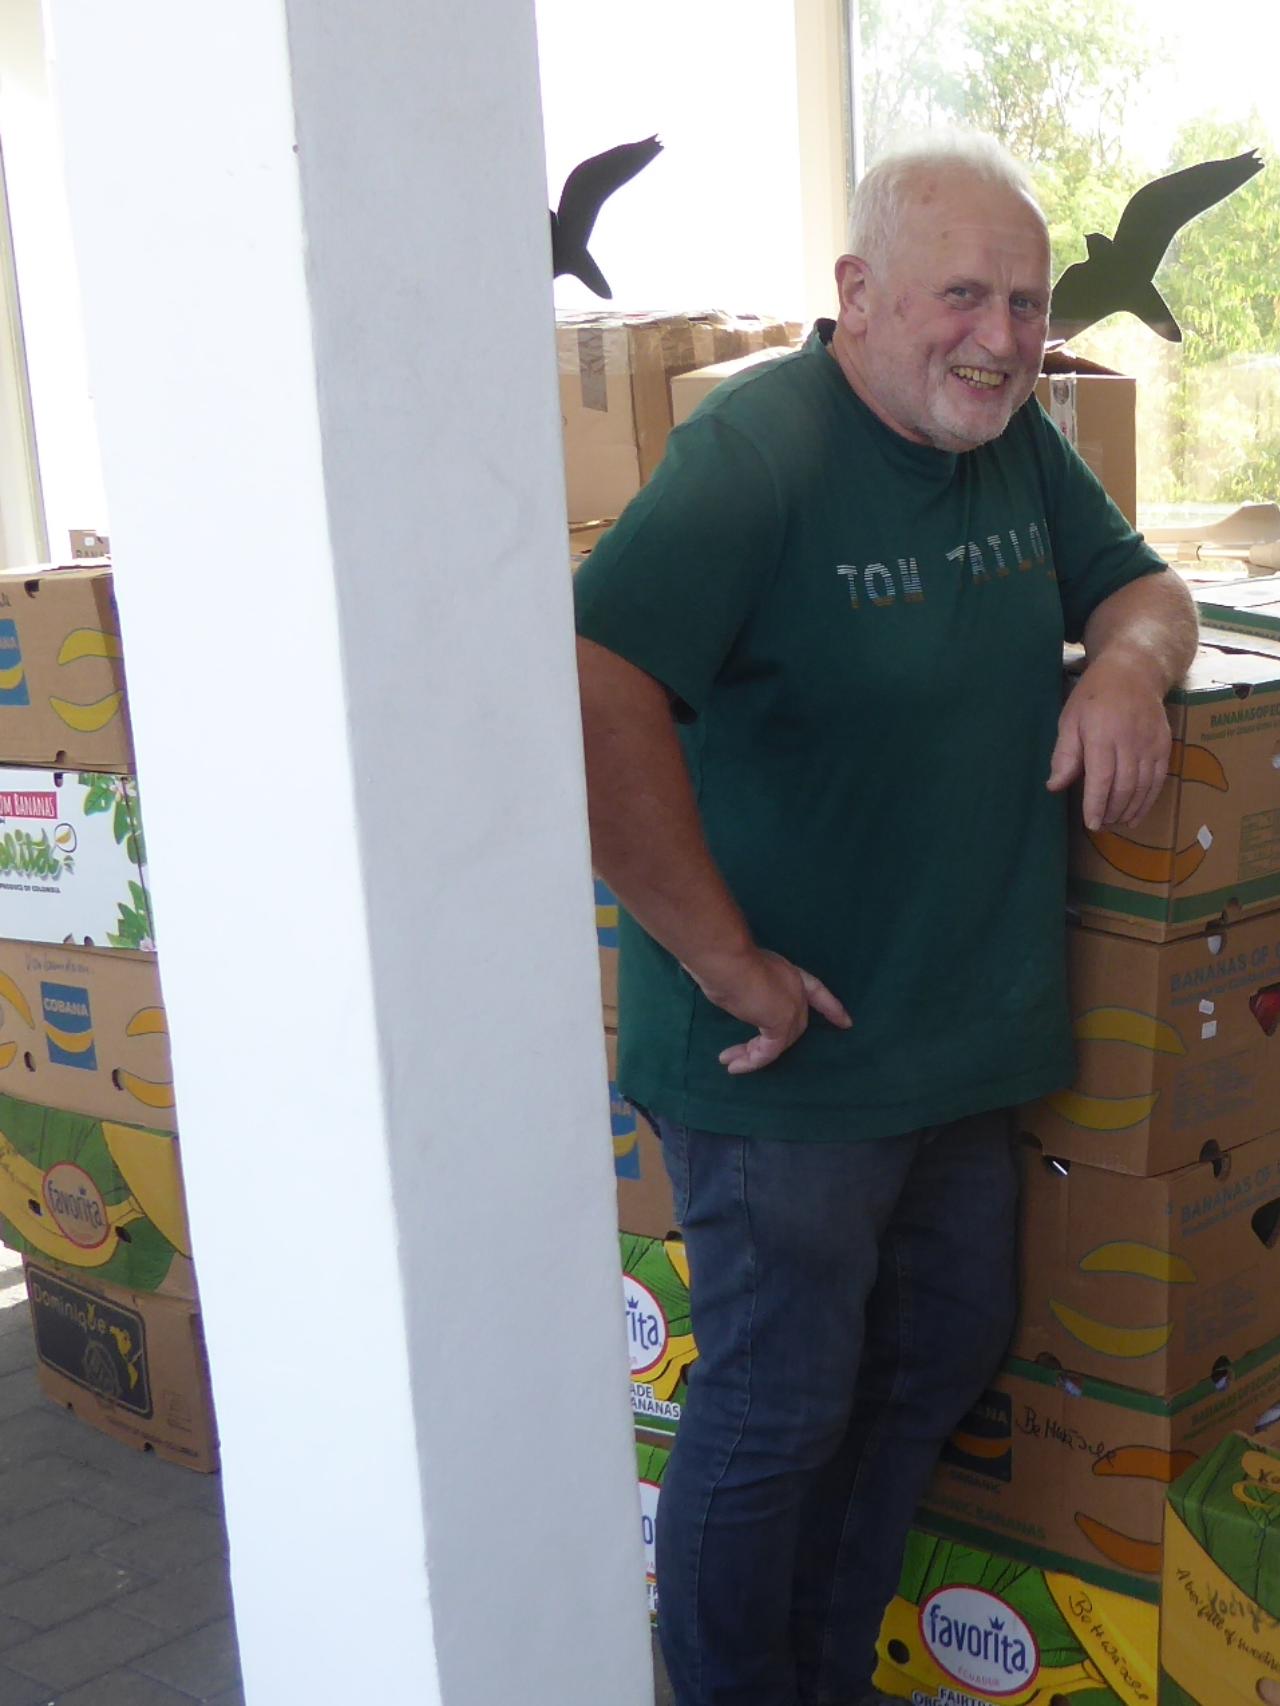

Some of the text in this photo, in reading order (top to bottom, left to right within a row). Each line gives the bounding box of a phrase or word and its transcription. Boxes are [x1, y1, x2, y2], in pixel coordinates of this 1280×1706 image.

[13, 793, 55, 818] BANANAS
[1171, 955, 1248, 992] BANANAS
[1251, 944, 1269, 967] OF
[44, 997, 88, 1017] COBANA
[47, 1180, 105, 1229] favorita
[1182, 1175, 1250, 1223] BANANAS
[1255, 1165, 1271, 1184] OF
[1176, 1567, 1191, 1581] A
[929, 1603, 1026, 1674] favorita
